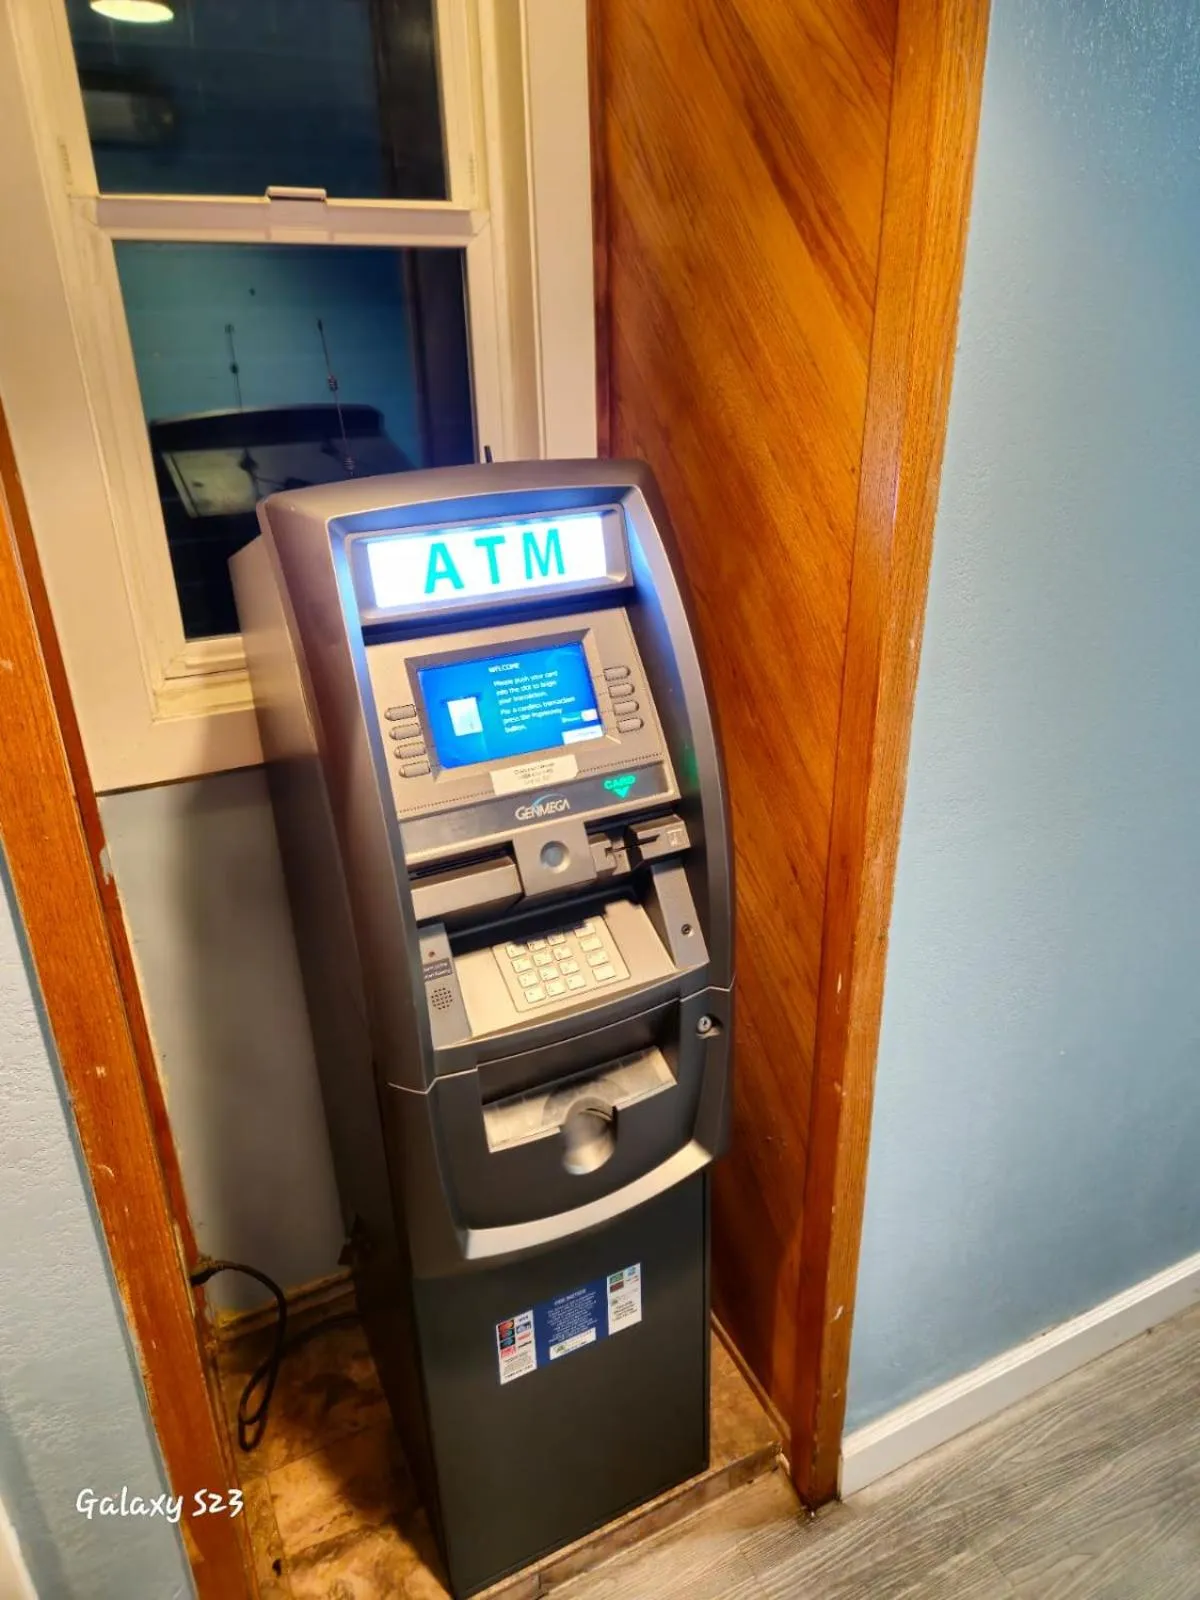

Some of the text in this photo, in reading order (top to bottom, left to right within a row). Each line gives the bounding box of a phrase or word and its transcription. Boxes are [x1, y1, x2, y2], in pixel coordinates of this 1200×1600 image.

[424, 527, 566, 594] ATM
[488, 662, 521, 673] WELCOME
[604, 775, 637, 791] CARD
[515, 798, 570, 821] GENMEGA
